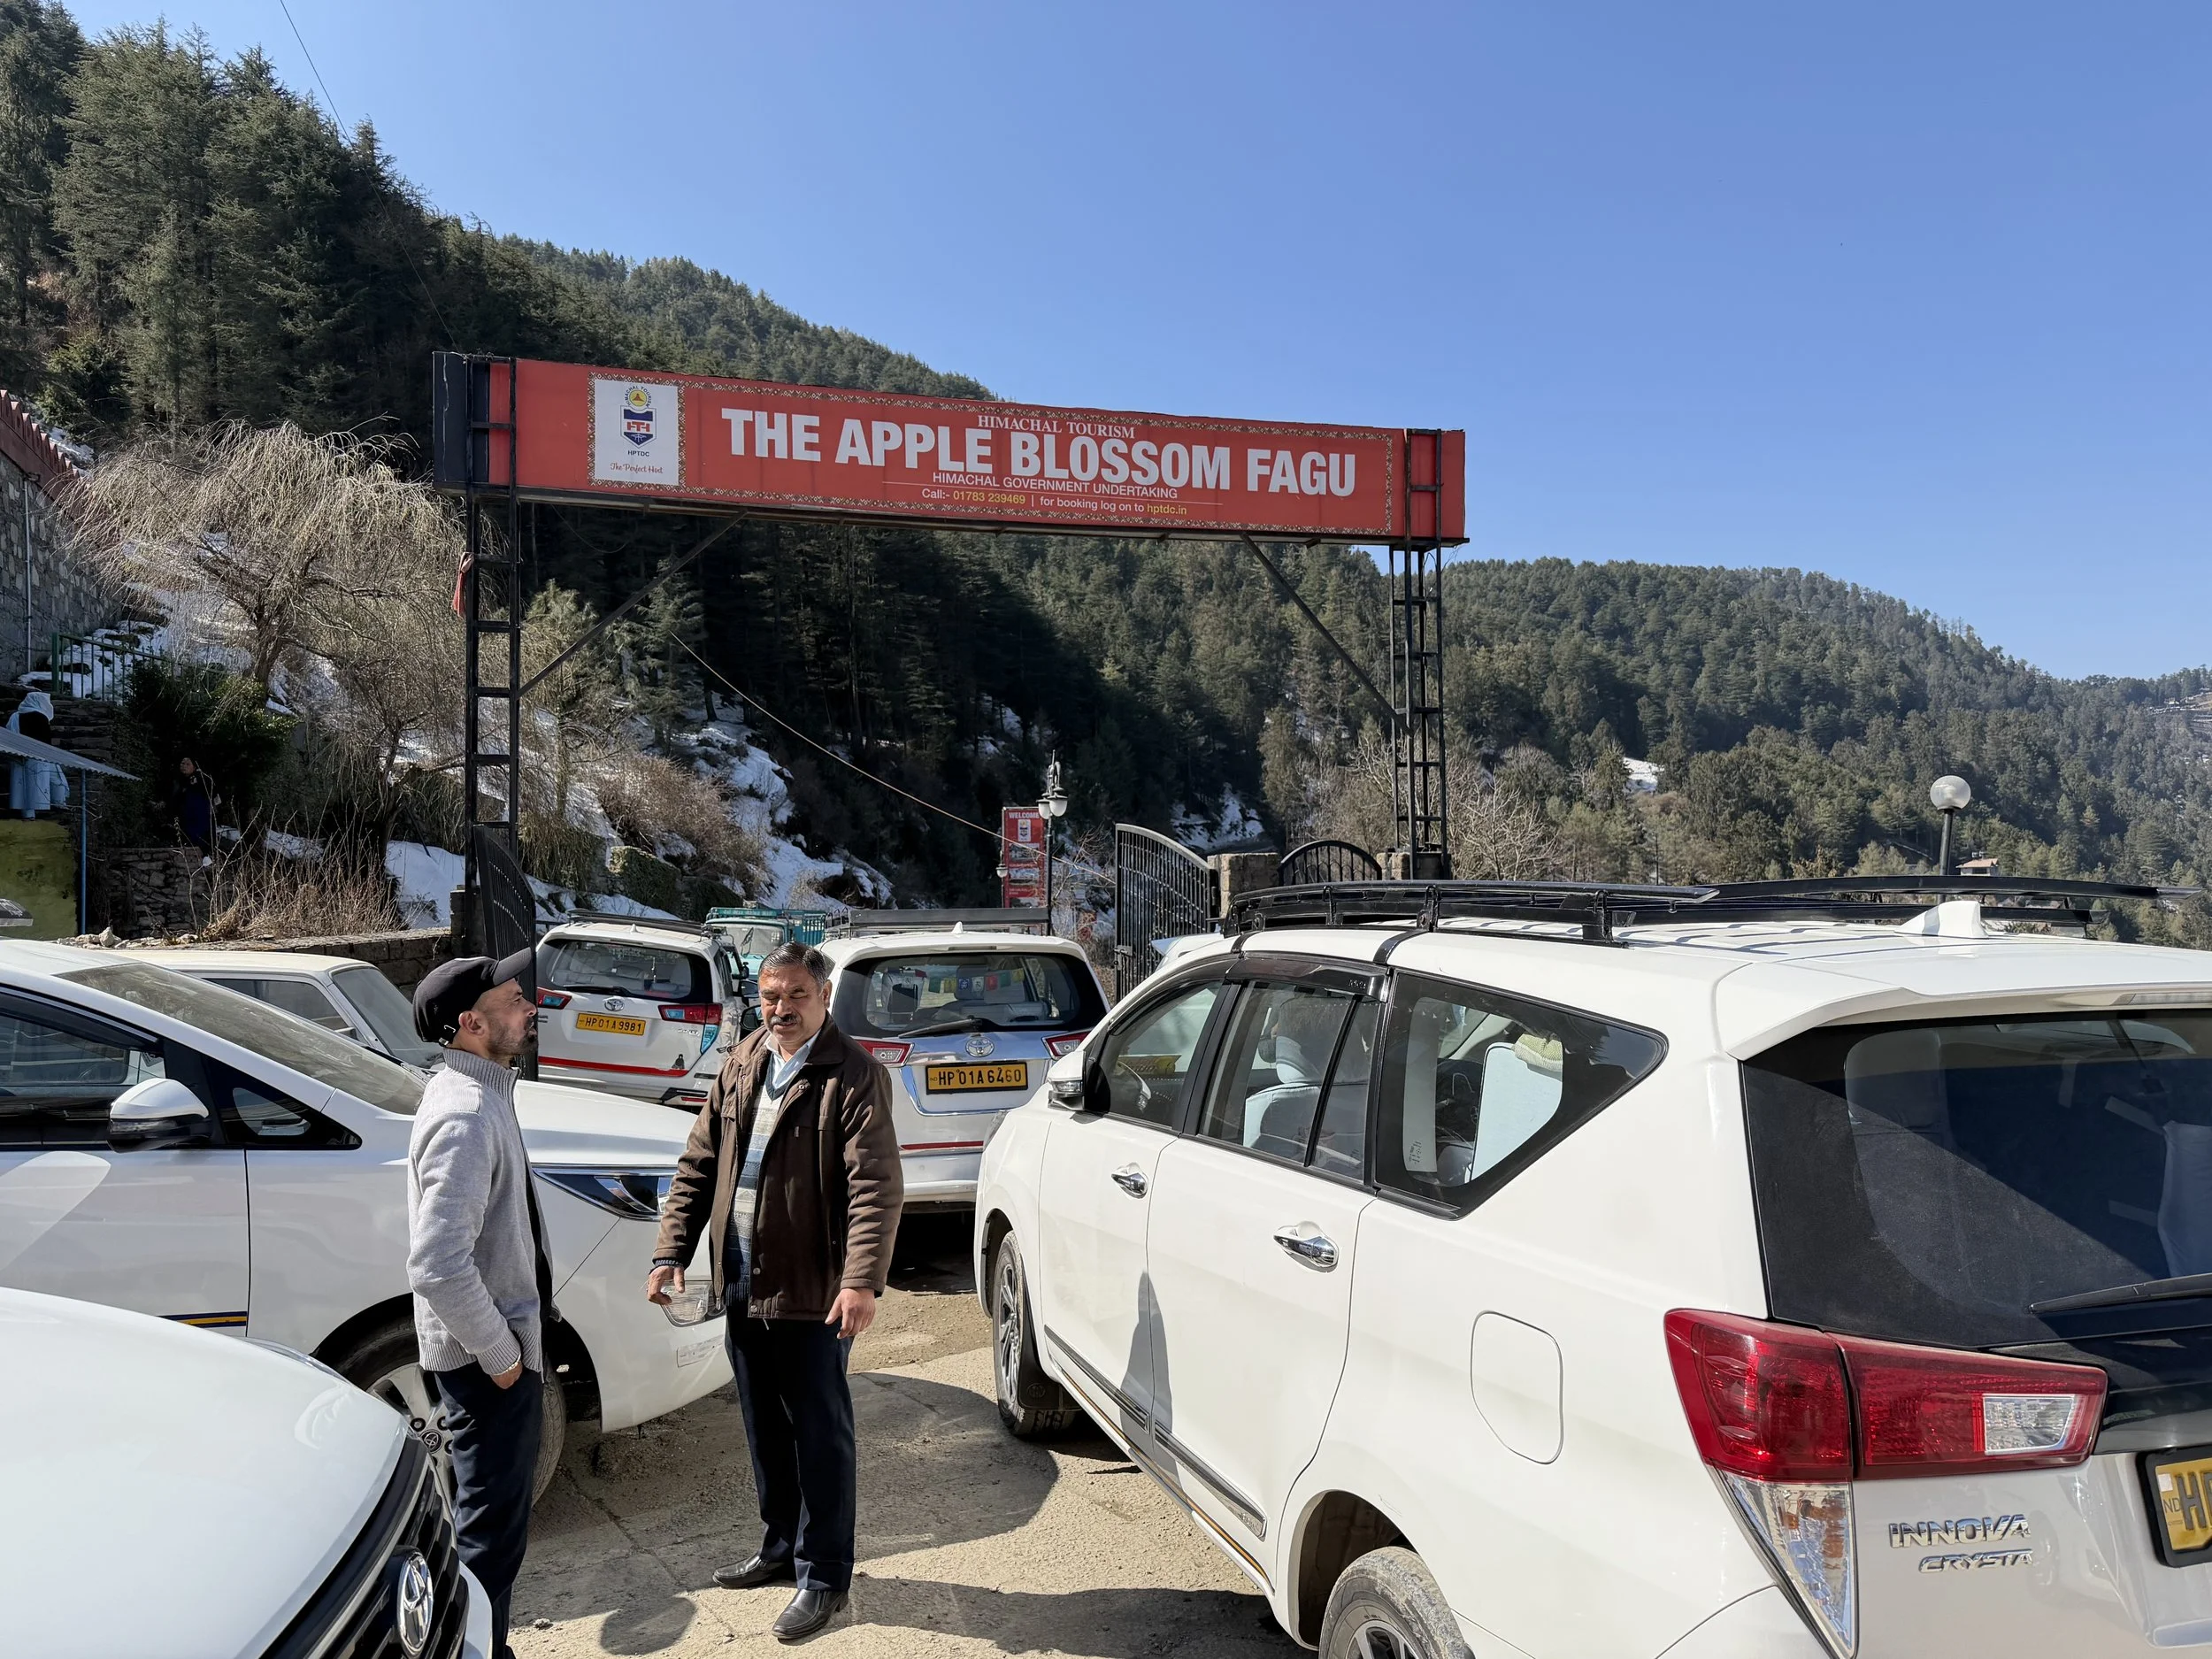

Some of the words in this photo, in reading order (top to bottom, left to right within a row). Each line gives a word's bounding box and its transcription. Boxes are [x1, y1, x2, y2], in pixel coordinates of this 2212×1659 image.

[978, 414, 1062, 434] HIMACHAL
[1067, 421, 1135, 439] TOURISM
[721, 408, 821, 462] THE
[835, 419, 993, 473] APPLE
[1010, 431, 1230, 490] BLOSSOM
[1247, 449, 1356, 496] FAGU
[611, 462, 622, 471] The
[623, 464, 647, 473] Perfect
[933, 472, 1000, 487] HIMACHAL
[1003, 477, 1090, 493] GOVERNMENT
[1094, 483, 1178, 499] UNDERTAKING
[922, 488, 949, 500] Call:-
[953, 490, 985, 502] 01783
[988, 493, 1025, 504] 239469
[1040, 496, 1056, 506] for
[1057, 497, 1098, 511] booking
[1101, 501, 1116, 512] log
[1134, 503, 1144, 512] to
[1147, 503, 1187, 515] hptdc.in
[1889, 1514, 2031, 1548] INNOVA
[1918, 1548, 2033, 1573] CRYSTA
